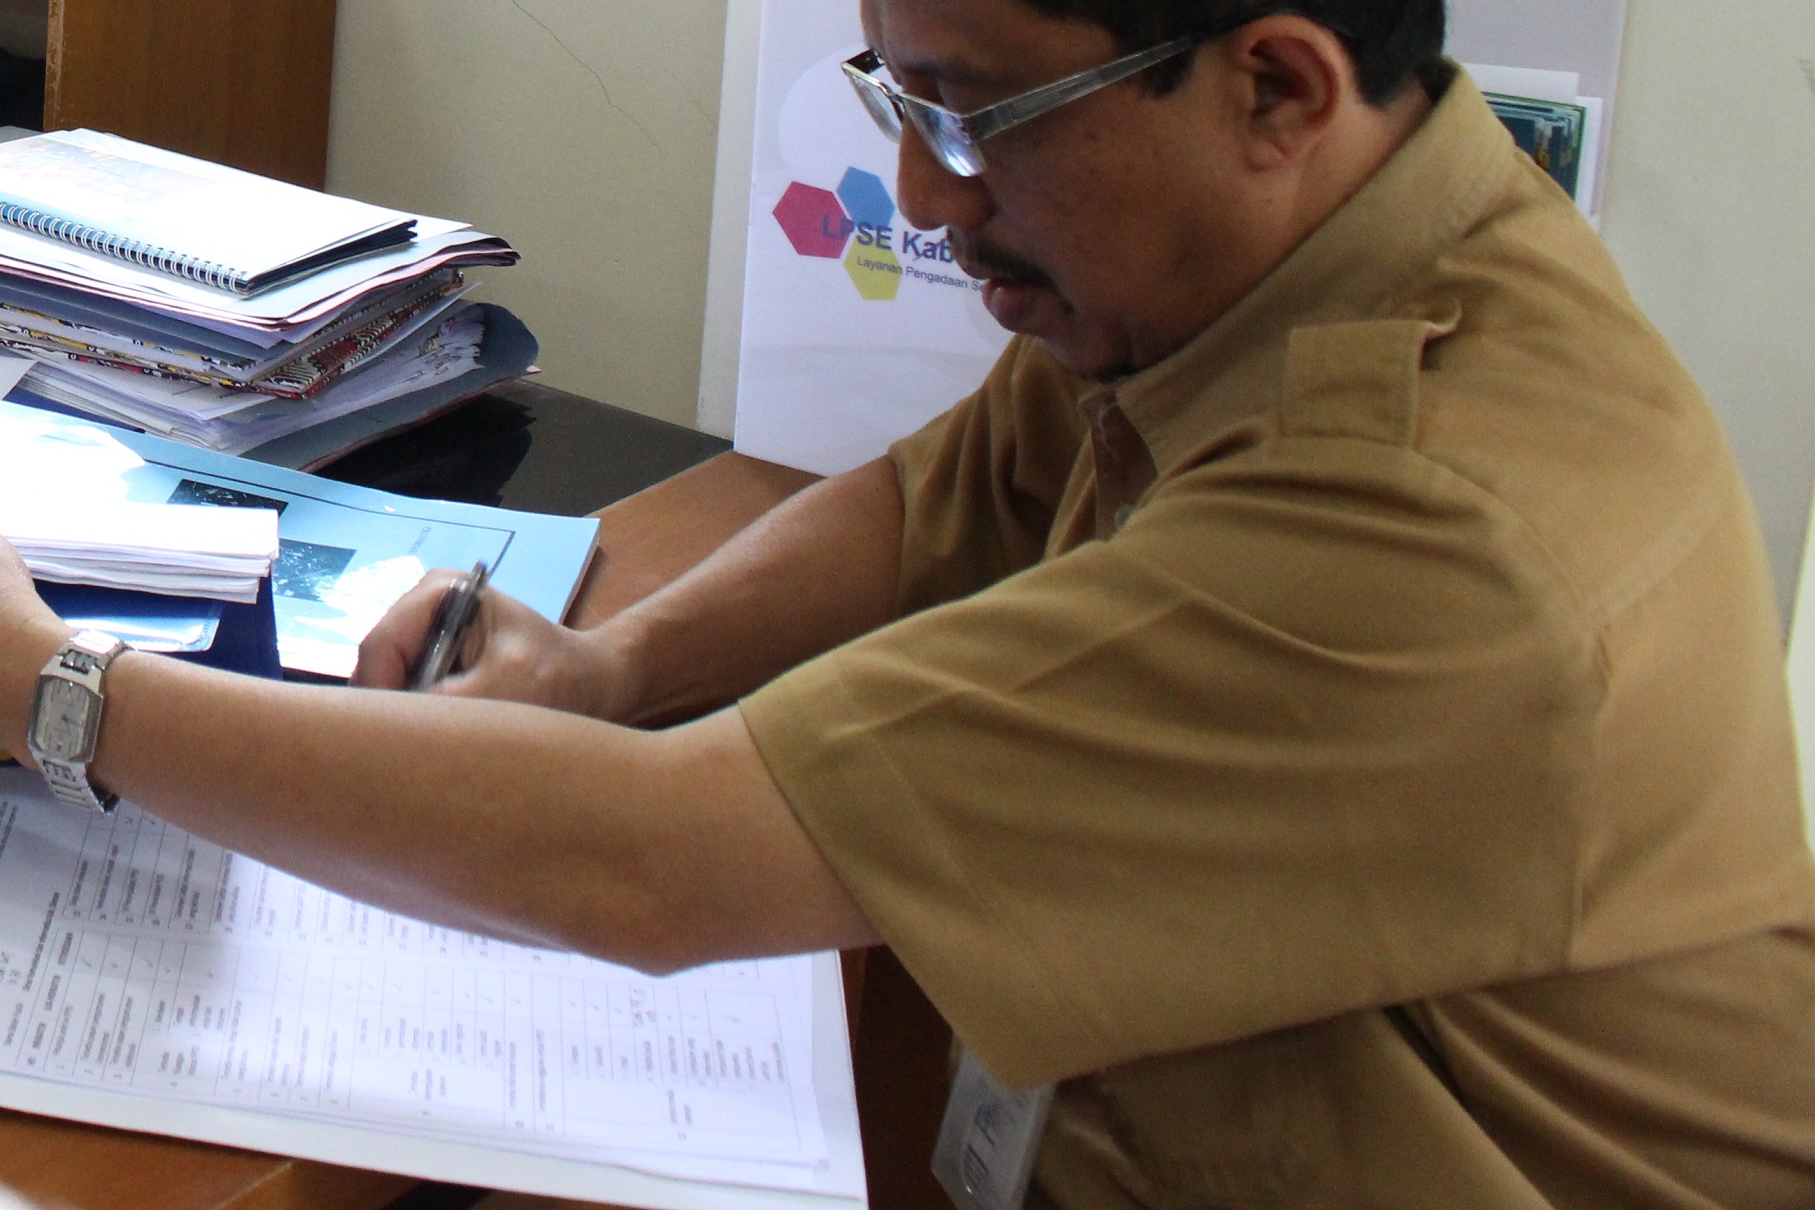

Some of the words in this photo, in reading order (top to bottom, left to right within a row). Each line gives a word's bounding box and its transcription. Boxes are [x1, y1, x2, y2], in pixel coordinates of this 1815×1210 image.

[822, 214, 892, 250] LPSE
[903, 231, 955, 263] Kab
[857, 256, 902, 275] Layanan
[906, 266, 968, 289] Pengadaan
